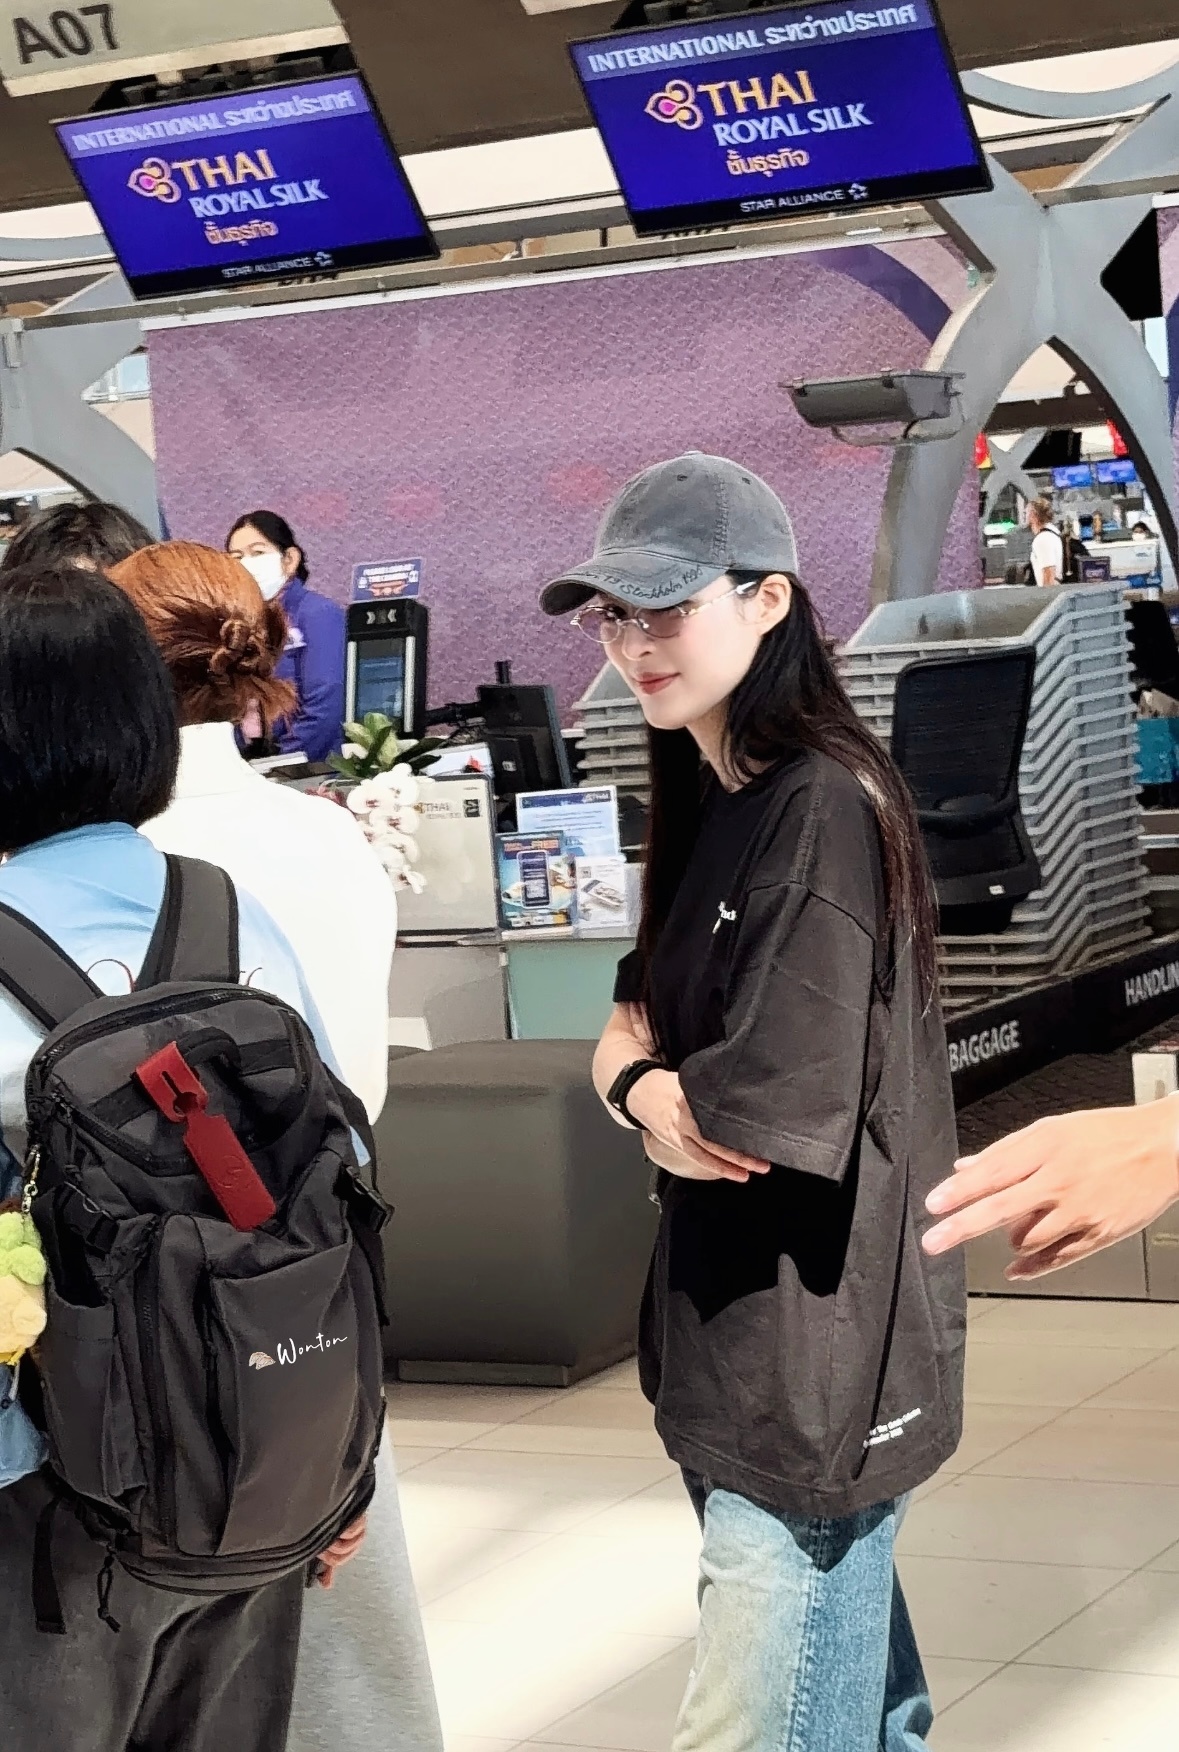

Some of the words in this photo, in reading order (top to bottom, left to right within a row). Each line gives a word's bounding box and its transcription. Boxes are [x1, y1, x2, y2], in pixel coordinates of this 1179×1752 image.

[13, 4, 118, 64] A07
[587, 29, 765, 73] INTERNATIONAL
[764, 3, 917, 45] ระหว่างประเทศ
[697, 70, 818, 116] THAI
[72, 112, 226, 150] INTERNATIONAL
[713, 113, 810, 146] ROYAL
[807, 103, 874, 133] SILK
[171, 149, 279, 191] THAI
[726, 148, 810, 177] ชั้นธุรกิจ
[188, 188, 275, 218] ROYAL
[270, 179, 329, 206] SILK
[740, 199, 777, 213] STAR
[778, 189, 845, 207] ALLIANCE
[221, 267, 253, 278] STAR
[254, 257, 314, 273] ALLIANCE
[948, 1020, 1020, 1072] BAGGAGE
